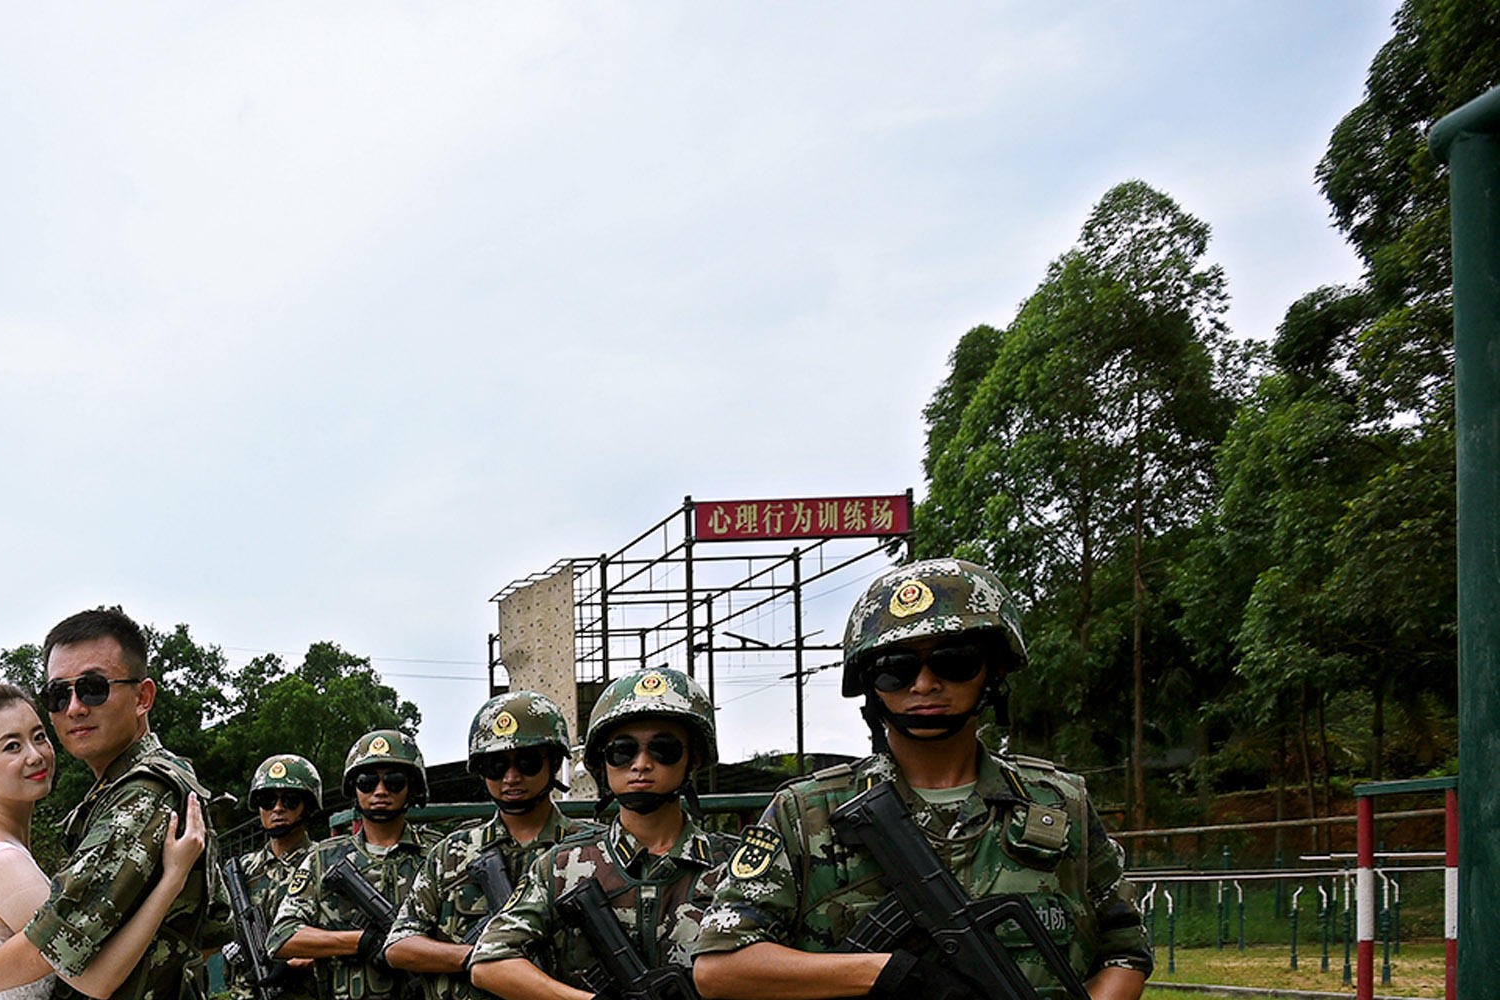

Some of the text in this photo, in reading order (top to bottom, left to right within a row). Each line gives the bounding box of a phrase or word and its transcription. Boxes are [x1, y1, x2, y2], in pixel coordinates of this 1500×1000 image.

[708, 499, 893, 535] 心理行为训练场
